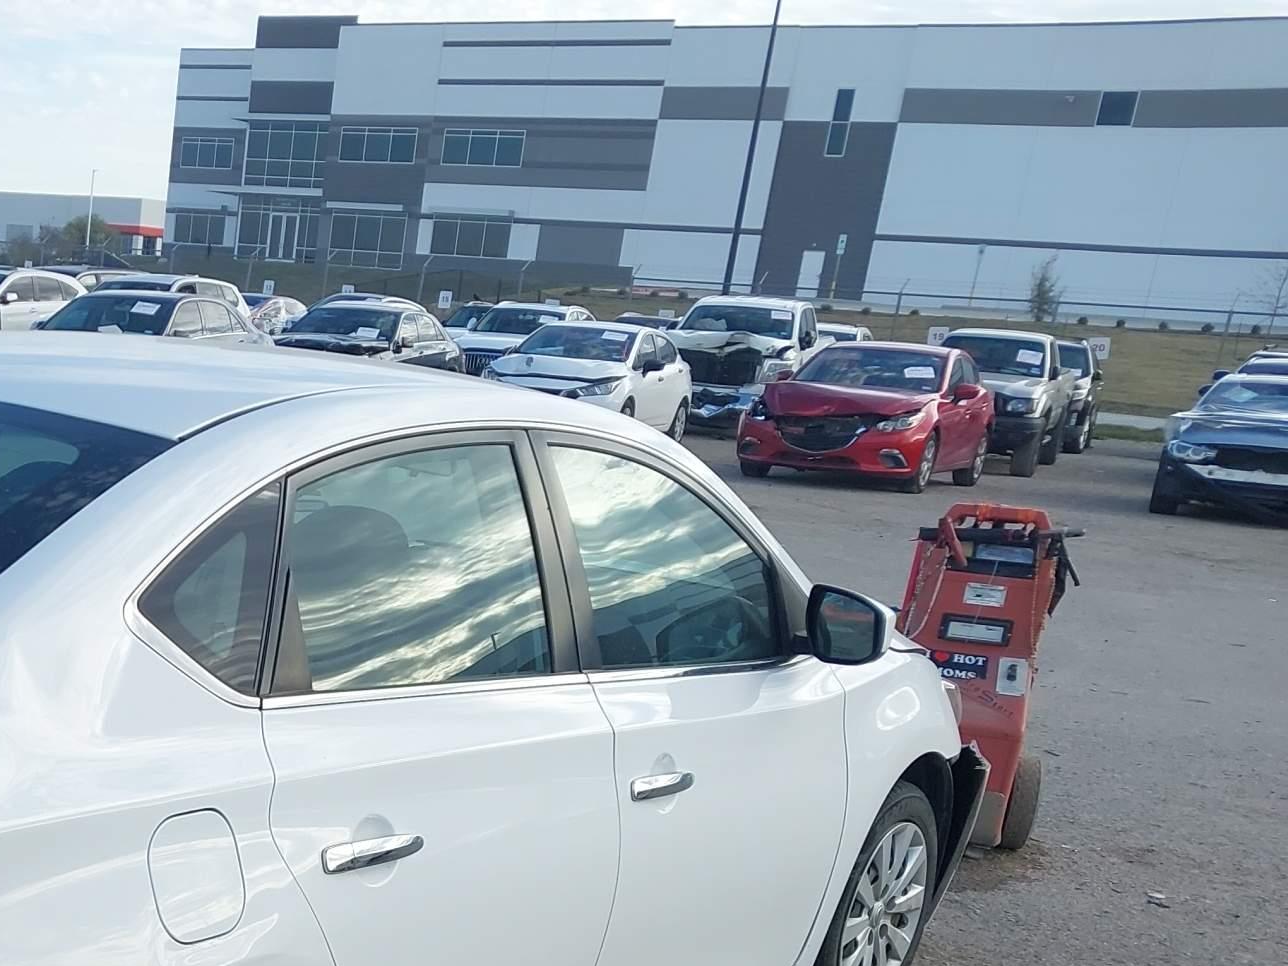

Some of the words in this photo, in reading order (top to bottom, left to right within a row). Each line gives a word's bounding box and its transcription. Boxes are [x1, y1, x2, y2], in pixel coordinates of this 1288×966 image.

[933, 332, 945, 341] 19
[1091, 343, 1106, 352] 20
[953, 654, 986, 665] HOT
